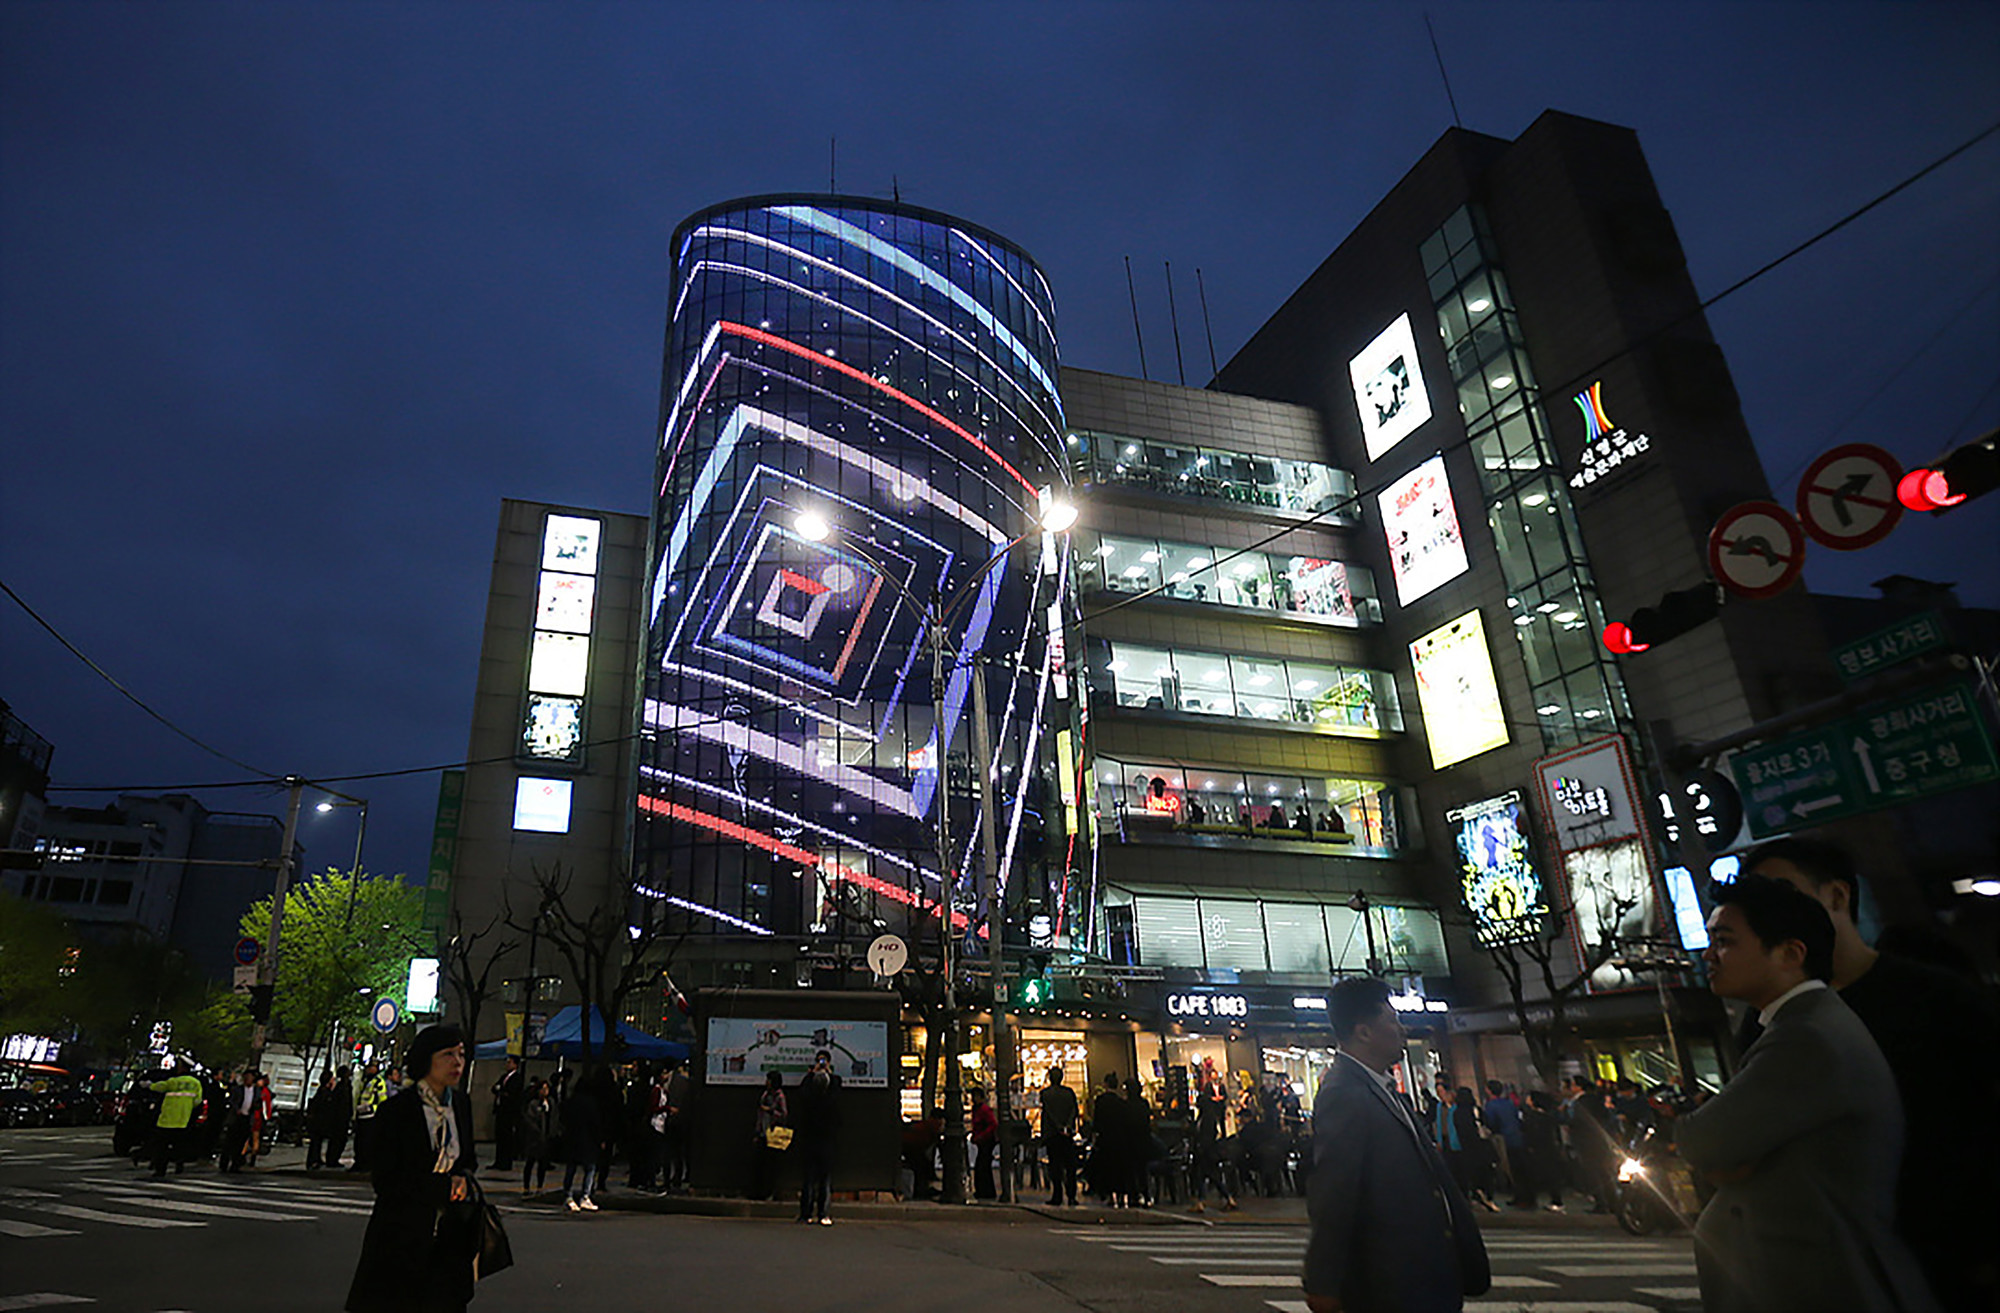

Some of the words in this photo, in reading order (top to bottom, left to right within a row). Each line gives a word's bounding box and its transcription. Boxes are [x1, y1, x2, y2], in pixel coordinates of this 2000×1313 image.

[1745, 740, 1832, 785] 을지로3가
[1885, 741, 1962, 780] 중구청
[1168, 995, 1208, 1015] CAFE
